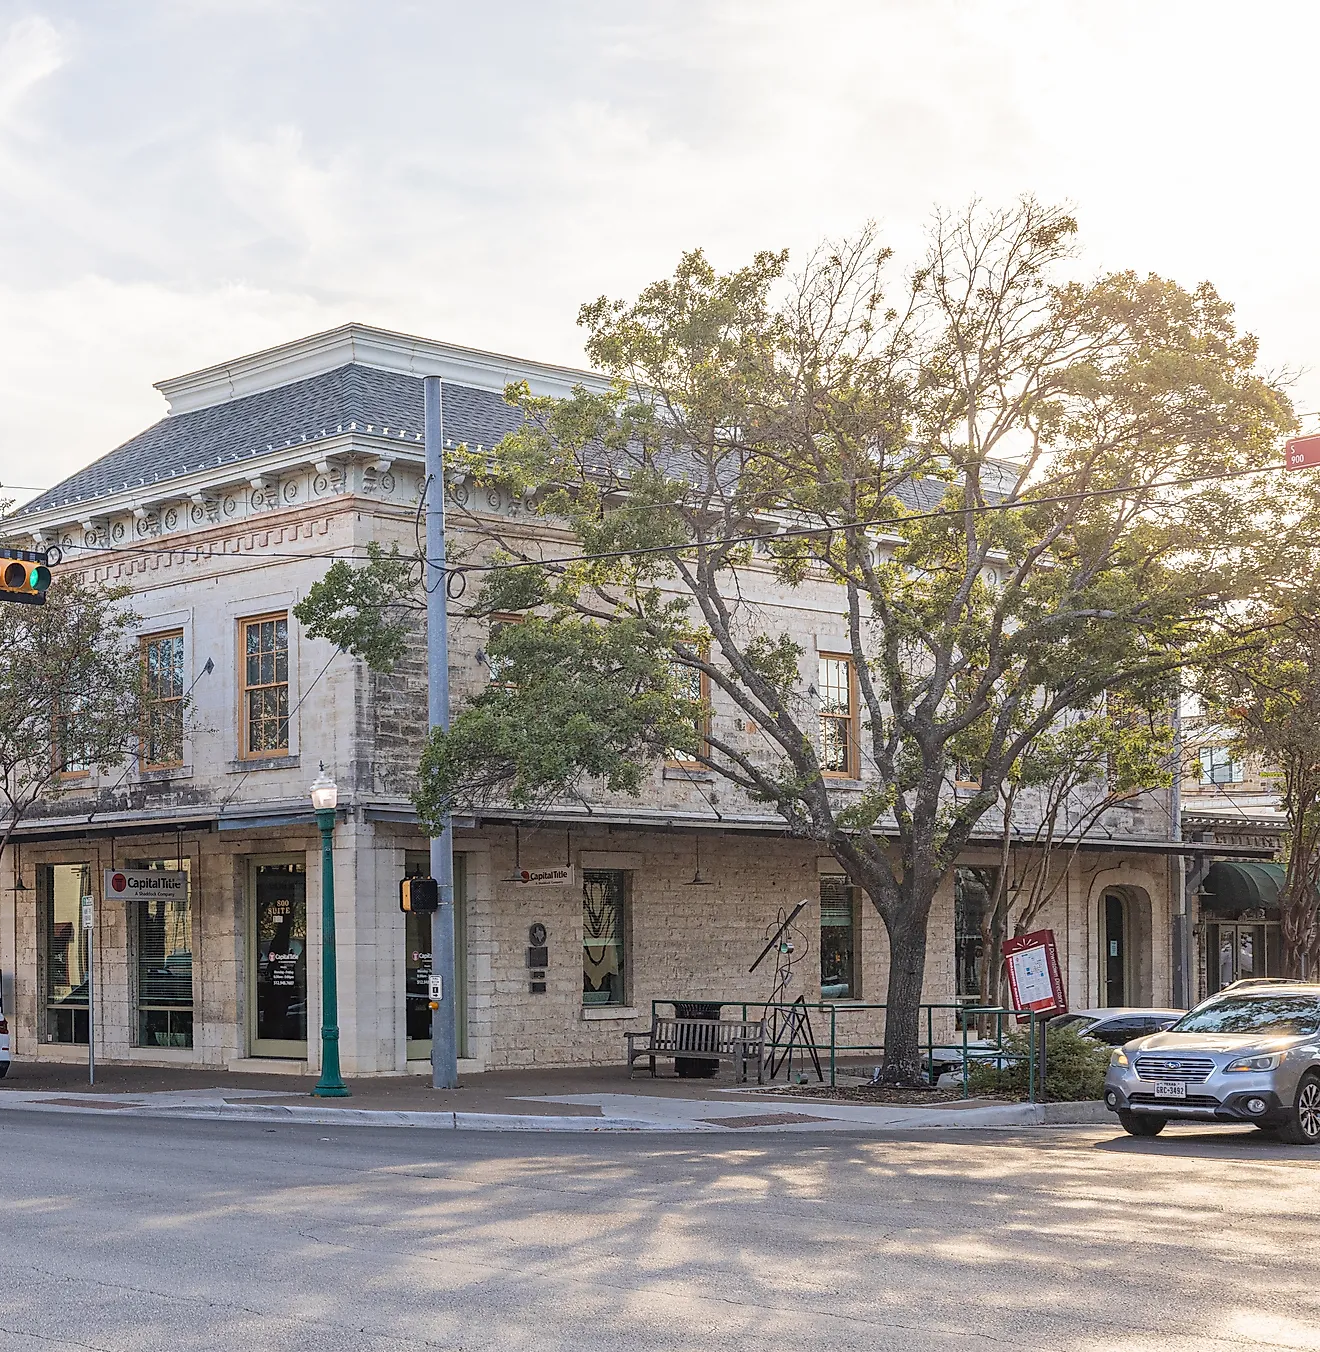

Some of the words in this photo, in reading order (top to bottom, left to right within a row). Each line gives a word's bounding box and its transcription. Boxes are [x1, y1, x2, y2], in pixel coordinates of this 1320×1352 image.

[1291, 445, 1295, 454] S
[1291, 454, 1305, 464] 900
[1048, 947, 1058, 977] Downtown
[1054, 977, 1064, 1004] Directory
